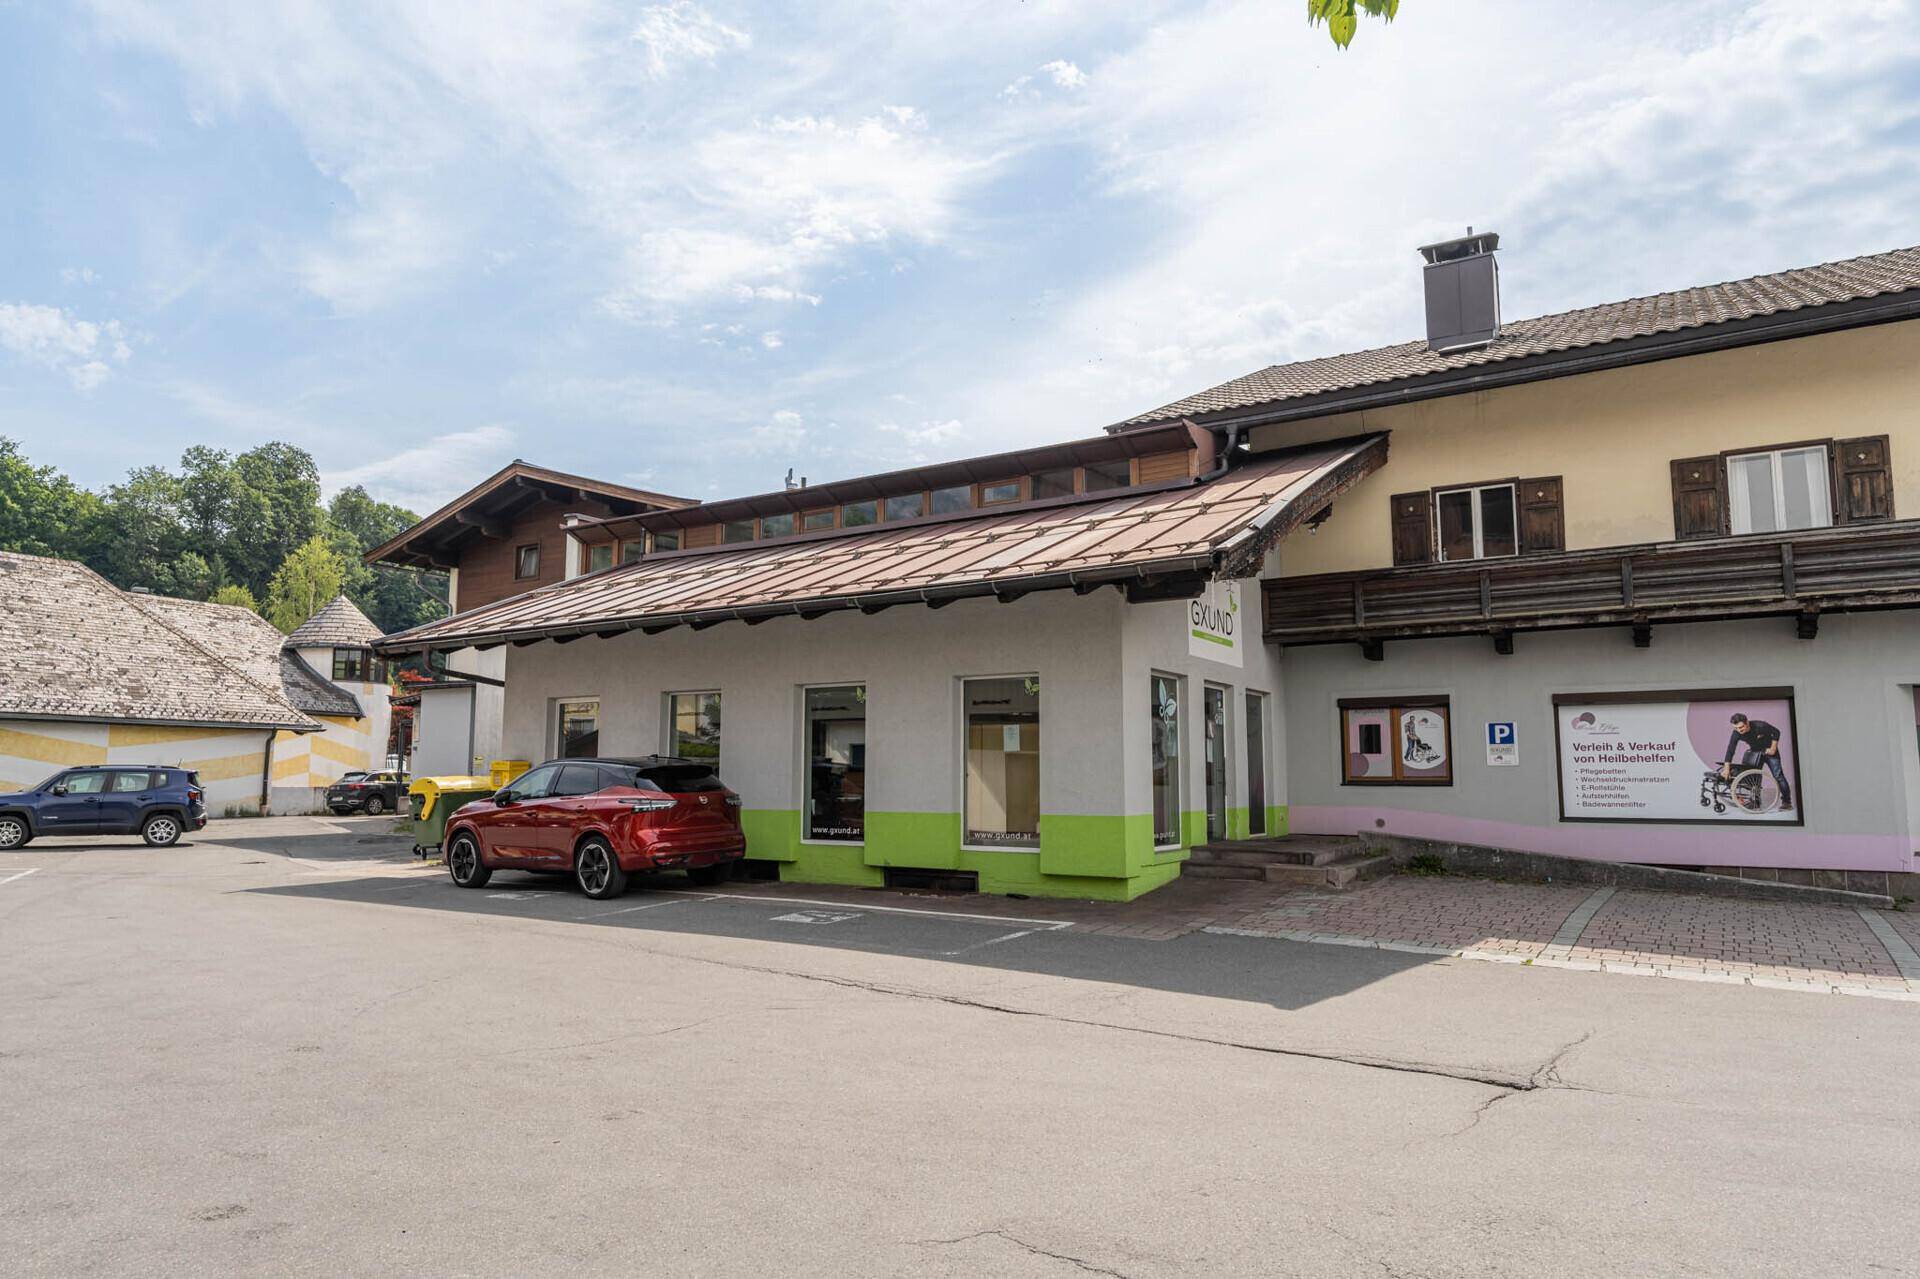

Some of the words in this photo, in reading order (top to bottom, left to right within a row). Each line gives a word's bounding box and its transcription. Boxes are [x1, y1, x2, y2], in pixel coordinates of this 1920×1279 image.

[1191, 600, 1234, 636] GXUND
[1494, 725, 1511, 744] P
[1572, 742, 1613, 752] Verleih
[1616, 742, 1625, 752] &
[1628, 741, 1676, 751] Verkauf
[1573, 755, 1595, 763] von
[1598, 753, 1675, 763] Heilbehelfen
[812, 826, 860, 836] www.gxund.at
[974, 831, 1031, 841] www.gxund.at
